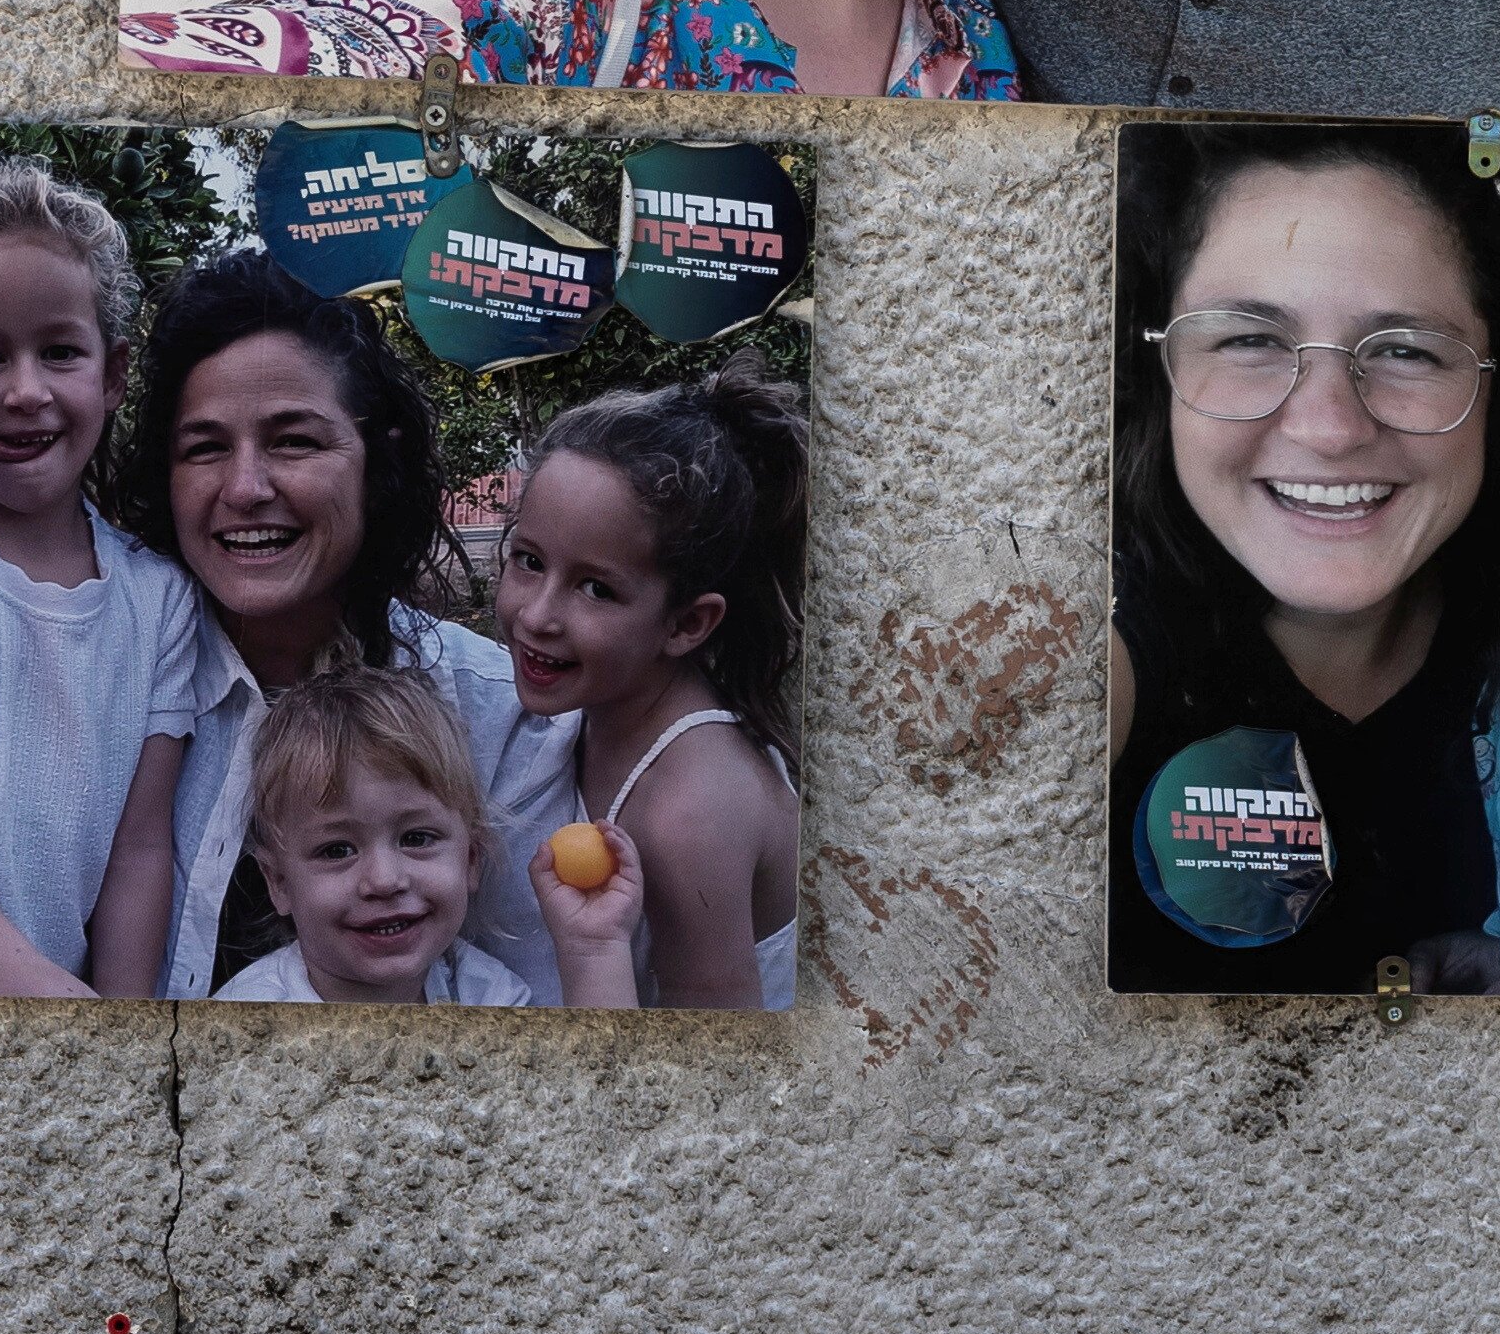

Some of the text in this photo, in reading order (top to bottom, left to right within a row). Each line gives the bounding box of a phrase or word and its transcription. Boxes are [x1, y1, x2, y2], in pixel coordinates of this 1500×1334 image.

[300, 151, 429, 199] סליחה,
[307, 189, 427, 216] איך מגיעים
[634, 188, 774, 230] התקווה
[287, 209, 430, 244] תיד משותף?
[447, 229, 585, 280] התקווה
[677, 256, 706, 268] דרכה
[710, 261, 727, 270] את
[429, 251, 591, 308] מדבקת!
[666, 267, 691, 279] קדם
[692, 268, 718, 279] תמר
[719, 270, 737, 282] של
[428, 296, 541, 323] של תמר קדם סימן טוב
[485, 298, 515, 310] דרכה
[517, 303, 534, 314] את
[1184, 786, 1315, 822] התקווה
[1171, 811, 1321, 851] מדבקת!
[1231, 850, 1260, 859] דרכה
[1263, 852, 1279, 860] את
[1176, 858, 1288, 871] של תמר קדם סימן טוב
